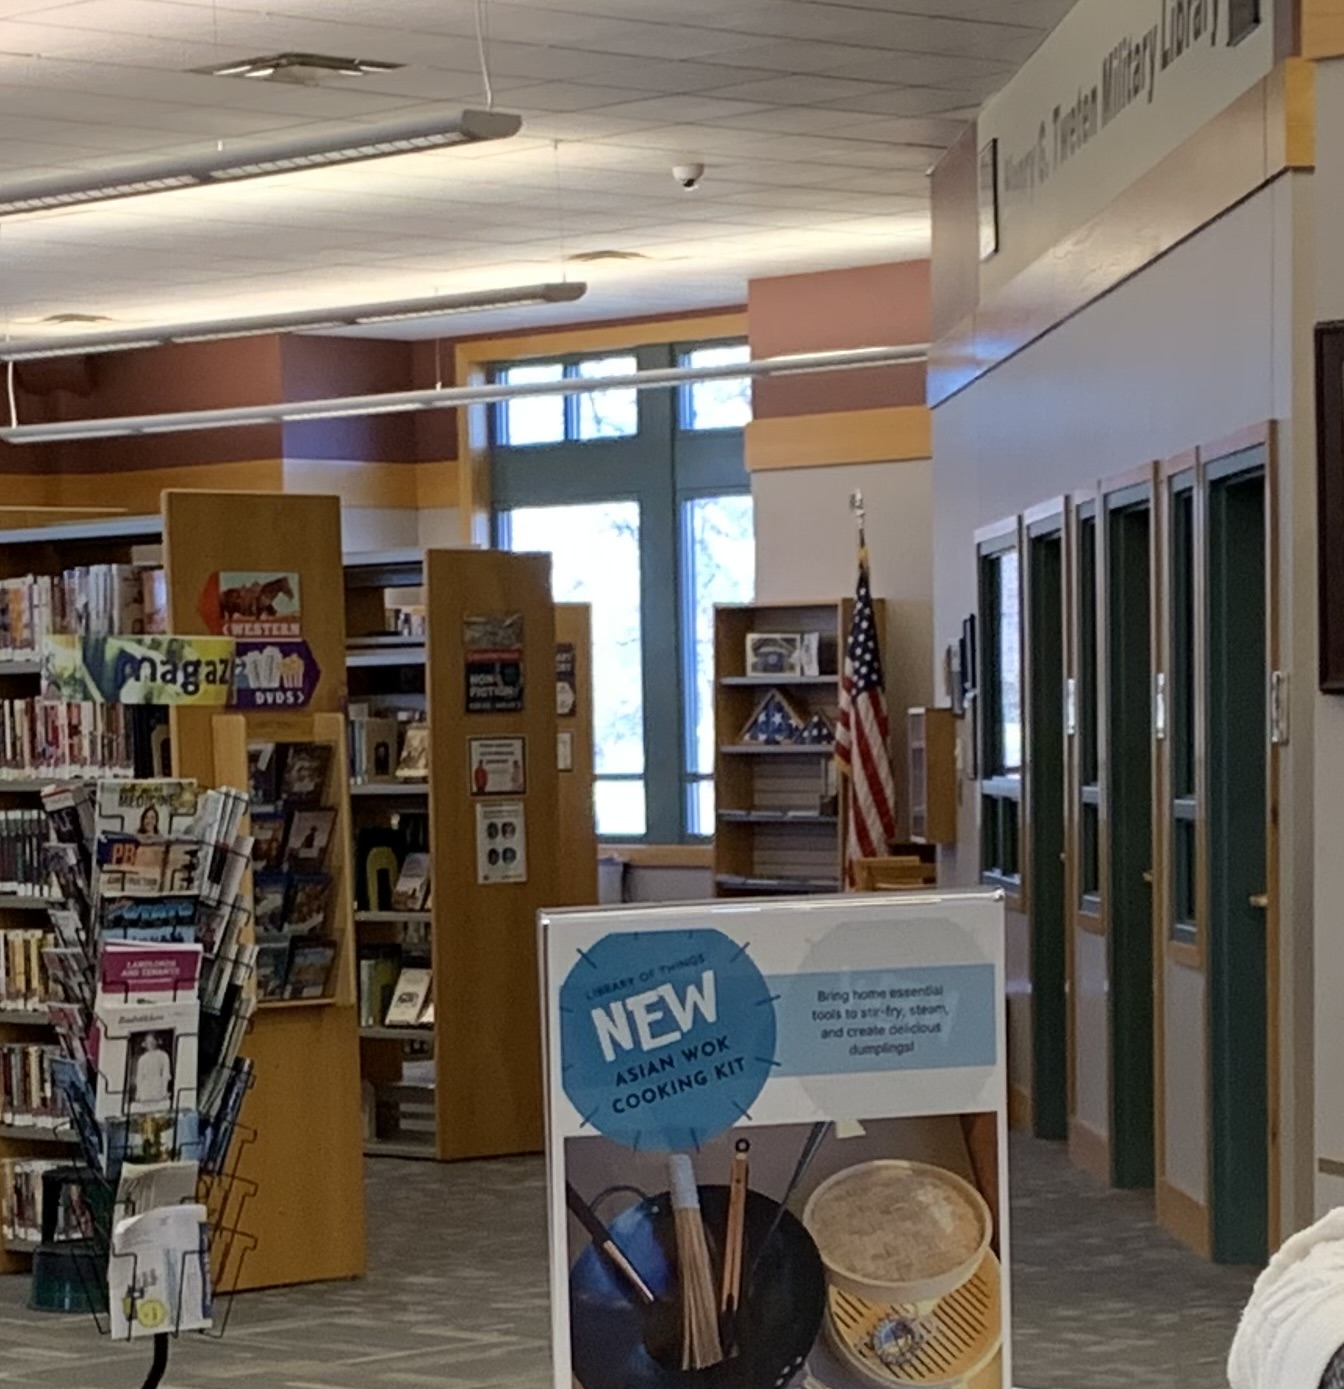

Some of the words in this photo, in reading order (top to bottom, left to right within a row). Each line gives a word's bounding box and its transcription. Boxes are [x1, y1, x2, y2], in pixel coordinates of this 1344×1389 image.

[1102, 23, 1158, 129] Military
[1160, 0, 1218, 72] Library
[231, 623, 301, 636] WESTERN
[255, 691, 294, 704] DVDS
[586, 977, 636, 1000] LIBRARY
[639, 969, 656, 983] OF
[659, 953, 706, 974] THINGS
[817, 990, 850, 1004] Bring
[853, 989, 887, 1000] home
[889, 985, 944, 998] essential
[591, 969, 717, 1063] NEW
[811, 1009, 842, 1021] tools
[845, 1009, 858, 1020] to
[821, 1027, 844, 1039] and
[847, 1026, 885, 1038] create
[889, 1022, 942, 1036] delicious
[615, 1054, 675, 1087] ASIAN
[681, 1036, 731, 1062] WOK
[612, 1070, 709, 1113] COOKING
[714, 1057, 747, 1080] KIT
